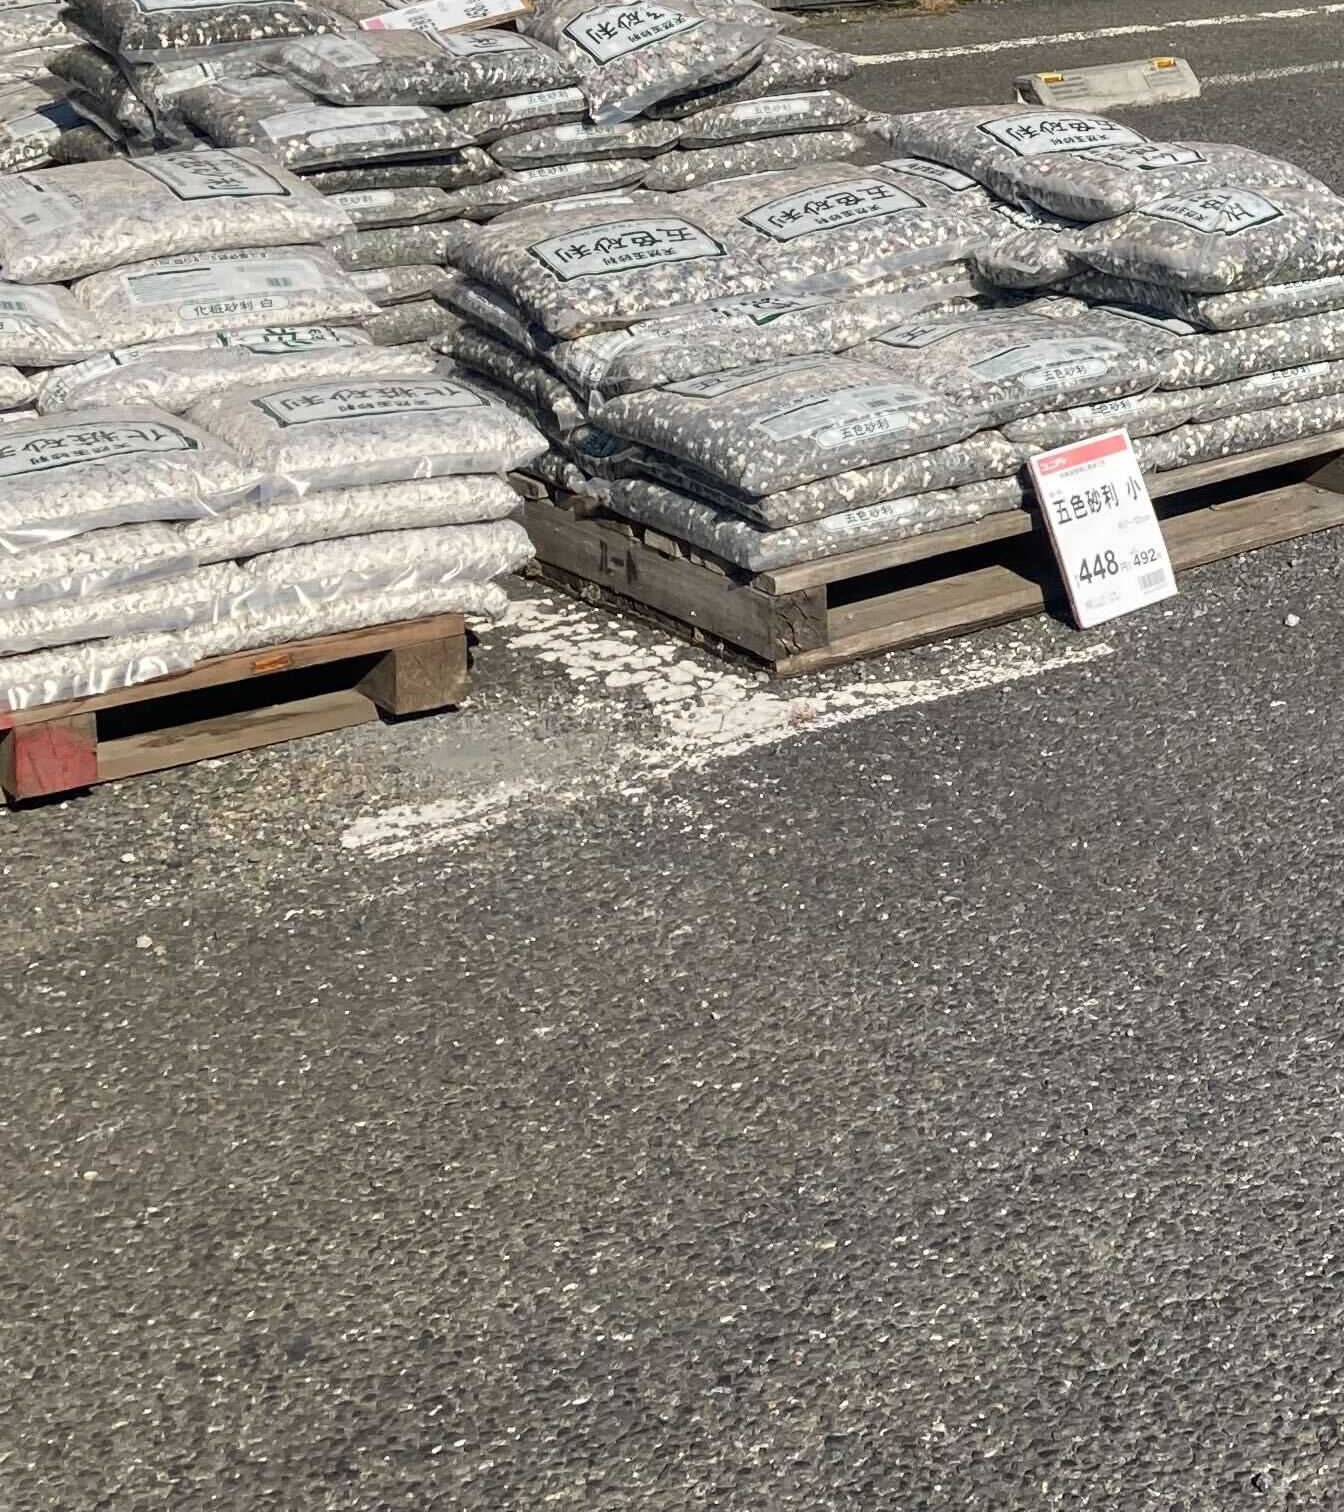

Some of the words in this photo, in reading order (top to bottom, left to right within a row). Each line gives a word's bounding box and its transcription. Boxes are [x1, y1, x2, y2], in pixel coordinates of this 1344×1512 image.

[1005, 119, 1121, 142] 五色砂利
[766, 185, 895, 229] 五色砂利
[554, 227, 697, 264] 五色砂利
[280, 386, 461, 411] 化粧砂利
[841, 417, 890, 440] 五色砂利
[1053, 481, 1120, 525] 五色砂利
[1126, 475, 1142, 501] 小
[1079, 550, 1119, 585] 448
[1132, 548, 1158, 567] 492
